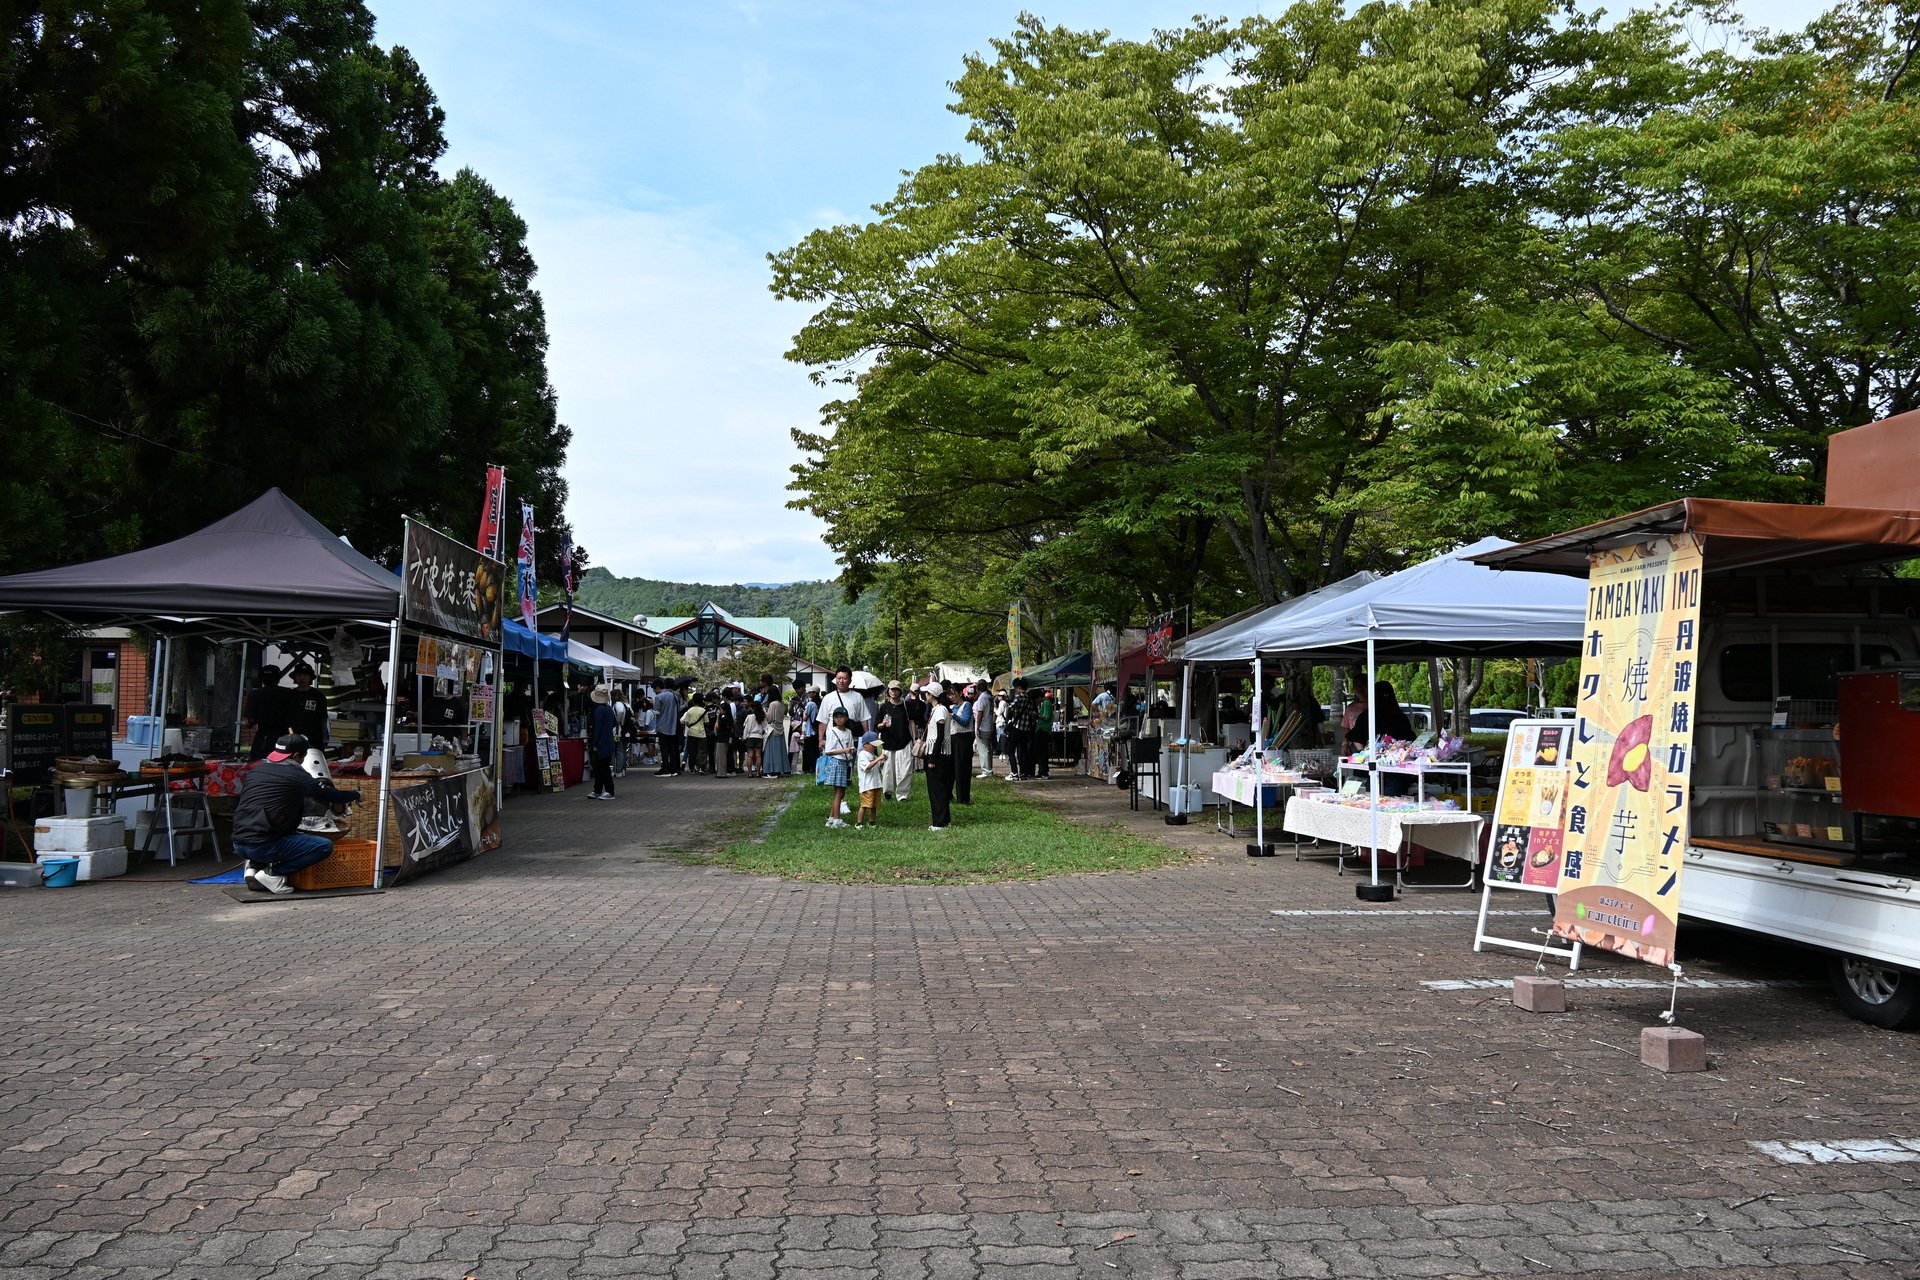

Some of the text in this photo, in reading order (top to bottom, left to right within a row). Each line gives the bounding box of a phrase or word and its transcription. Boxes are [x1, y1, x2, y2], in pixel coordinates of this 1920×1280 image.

[1588, 568, 1699, 622] TAMBAYAKI IMO
[1563, 629, 1604, 880] ホクしと食感
